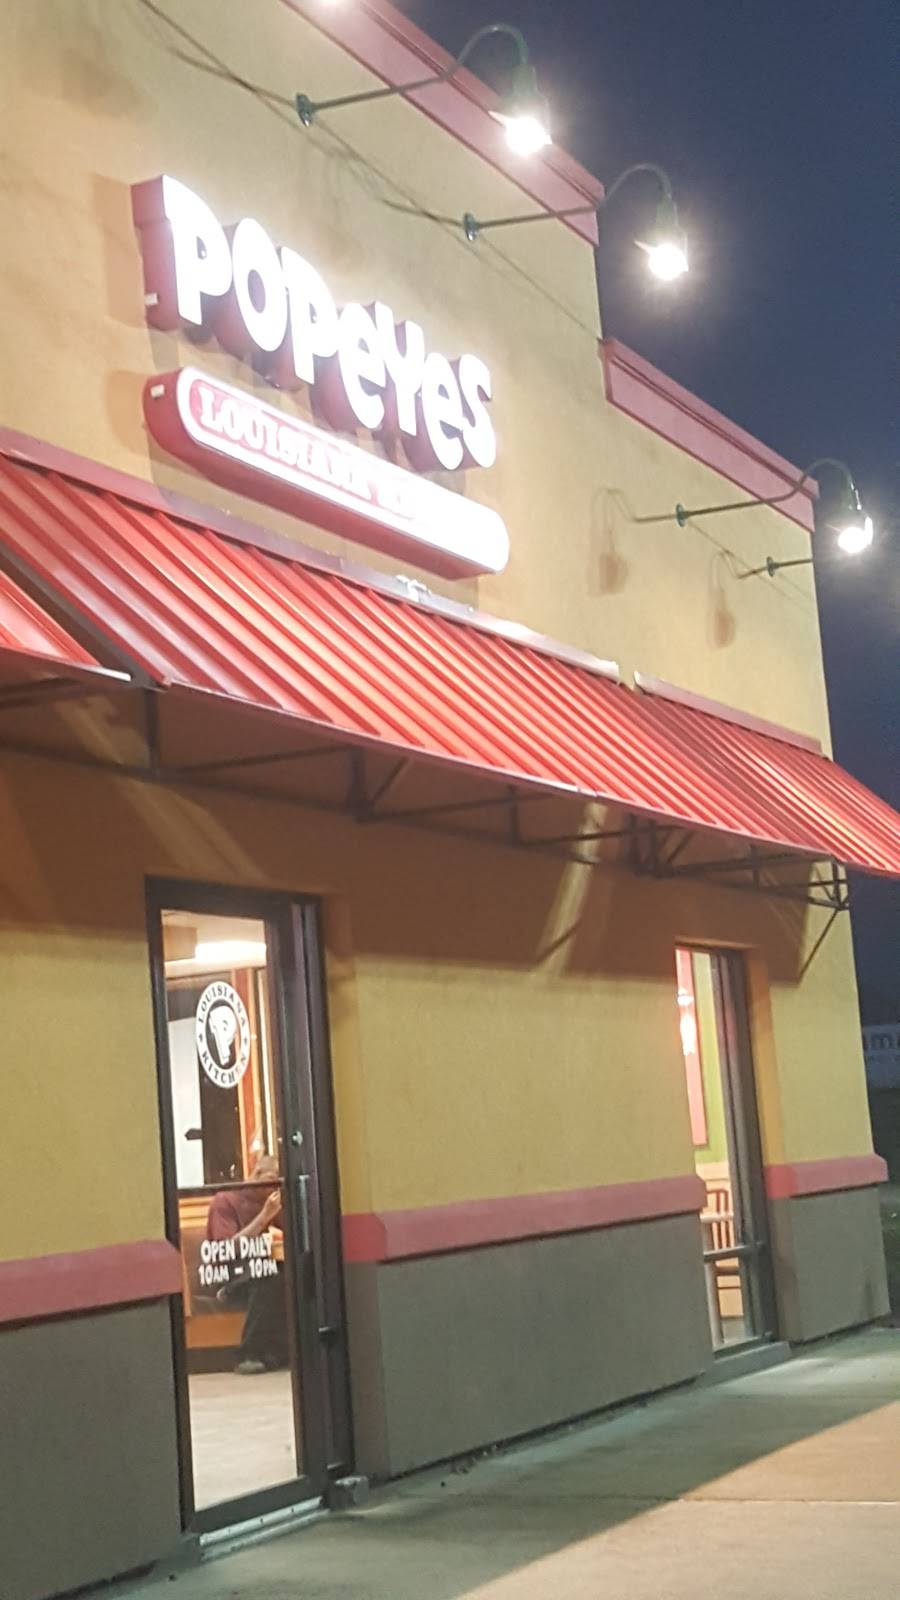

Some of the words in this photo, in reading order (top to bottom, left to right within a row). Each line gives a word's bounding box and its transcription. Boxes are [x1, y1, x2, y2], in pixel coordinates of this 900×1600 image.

[198, 985, 246, 1027] LOUISIANA
[200, 1239, 236, 1264] OPEN
[240, 1232, 273, 1259] DAILY
[198, 1264, 230, 1285] 10AM
[248, 1257, 279, 1279] 10PM
